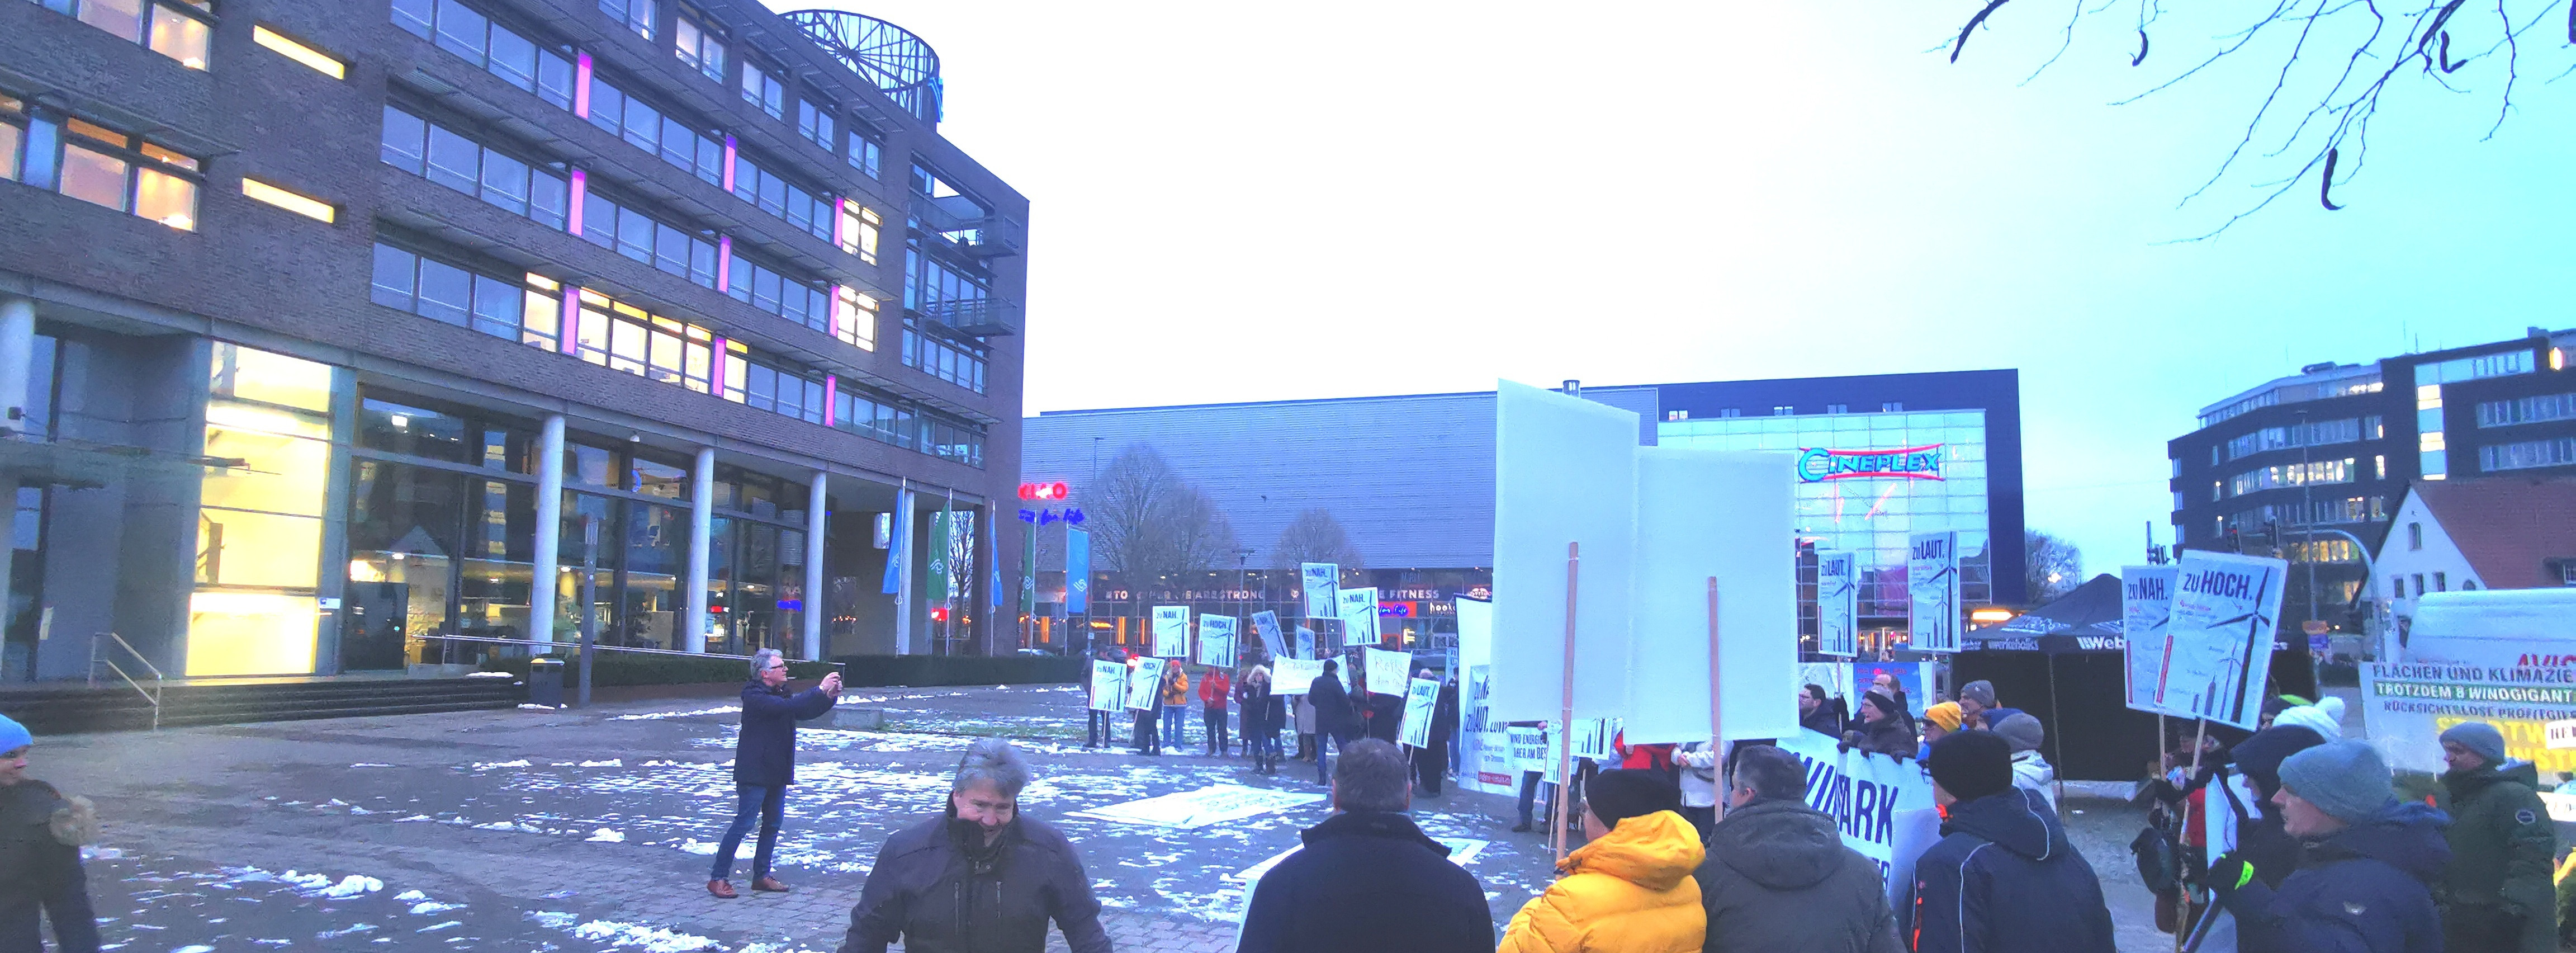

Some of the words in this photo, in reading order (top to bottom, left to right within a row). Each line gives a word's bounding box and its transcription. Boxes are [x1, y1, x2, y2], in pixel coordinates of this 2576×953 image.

[1798, 447, 1942, 483] CINEPLEX
[1389, 589, 1440, 600] FITNESS
[2139, 577, 2168, 601] NAH.
[2200, 570, 2253, 600] HOCH.
[2446, 666, 2483, 681] UND
[2377, 683, 2452, 699] TROTZDEM
[2469, 687, 2573, 703] WINDGIGANT
